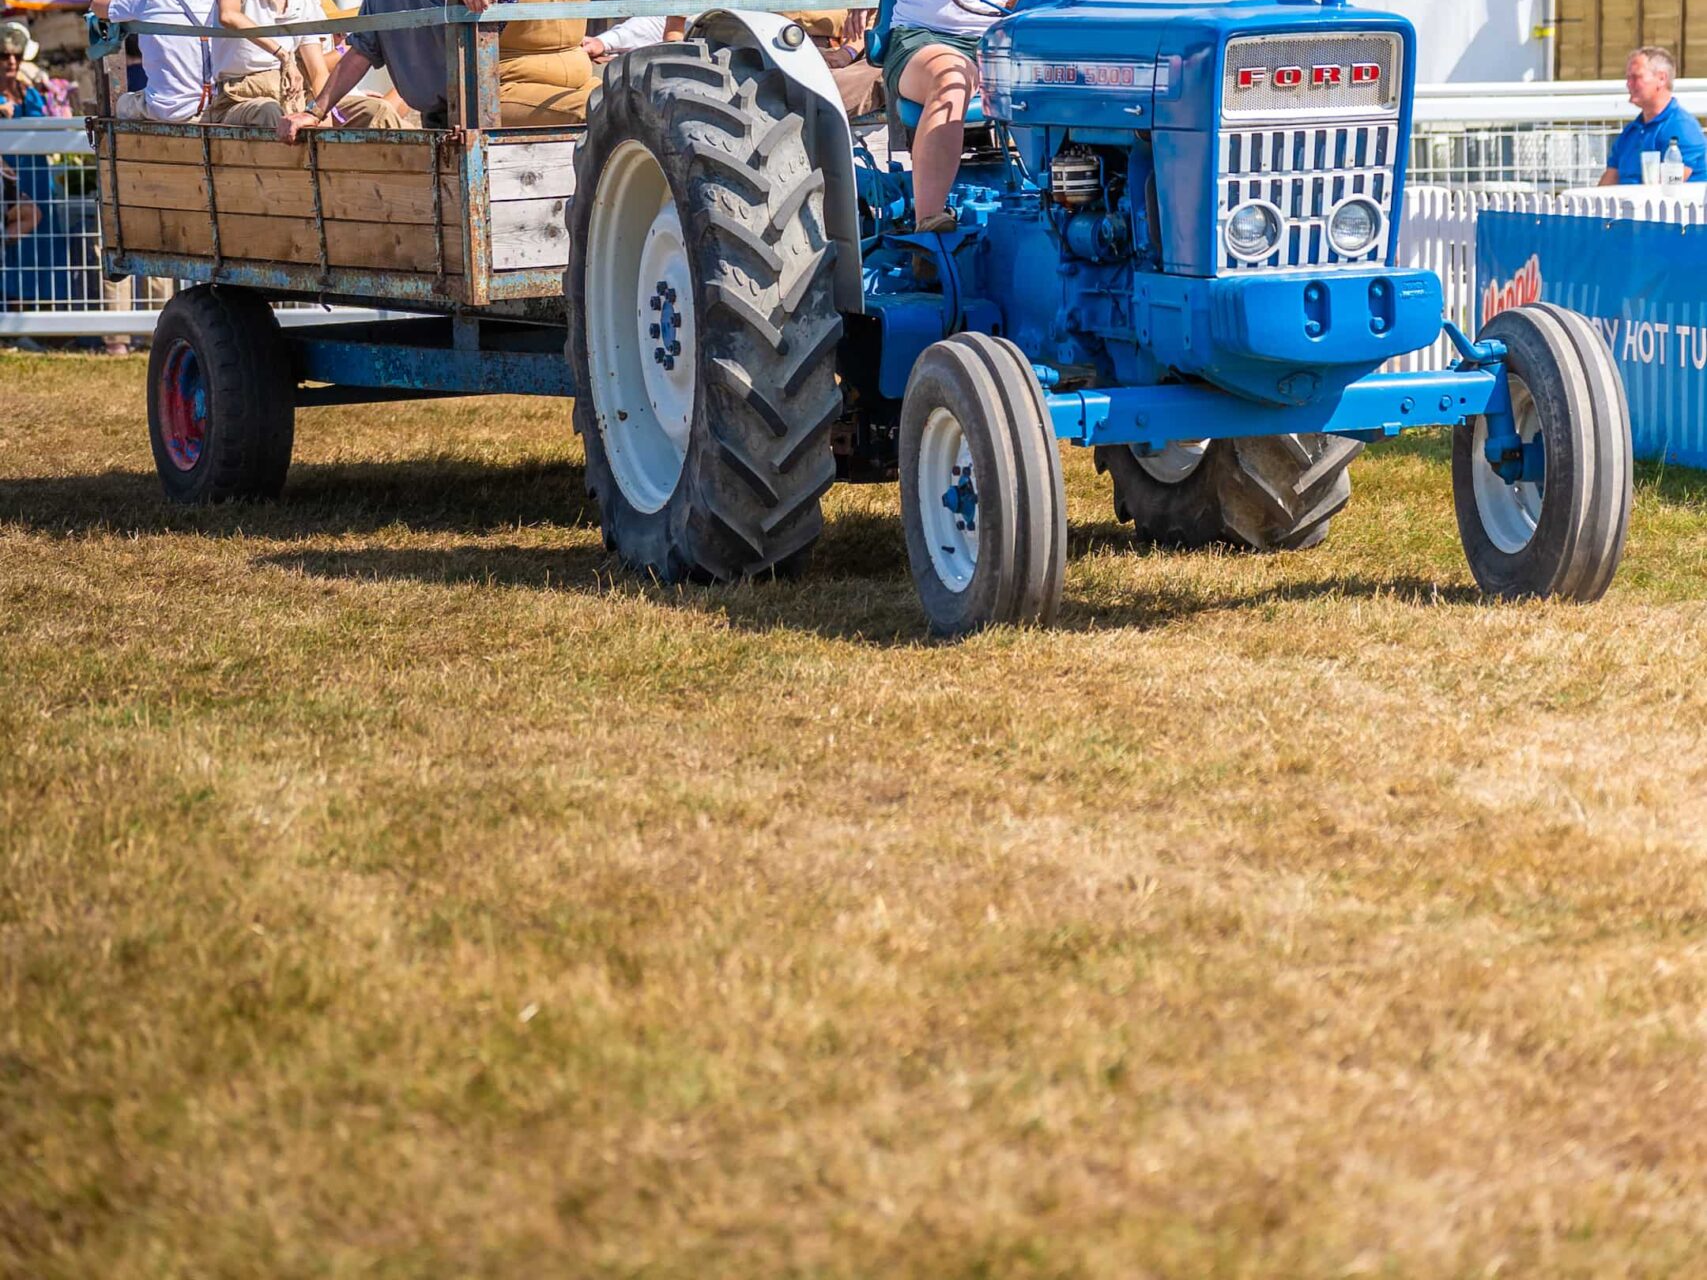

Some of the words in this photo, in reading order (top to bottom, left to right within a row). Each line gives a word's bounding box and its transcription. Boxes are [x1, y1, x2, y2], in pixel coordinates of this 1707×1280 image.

[1031, 64, 1077, 84] FORD
[1083, 65, 1134, 86] 5000
[1237, 63, 1381, 88] FORD
[1623, 319, 1669, 365] HOT
